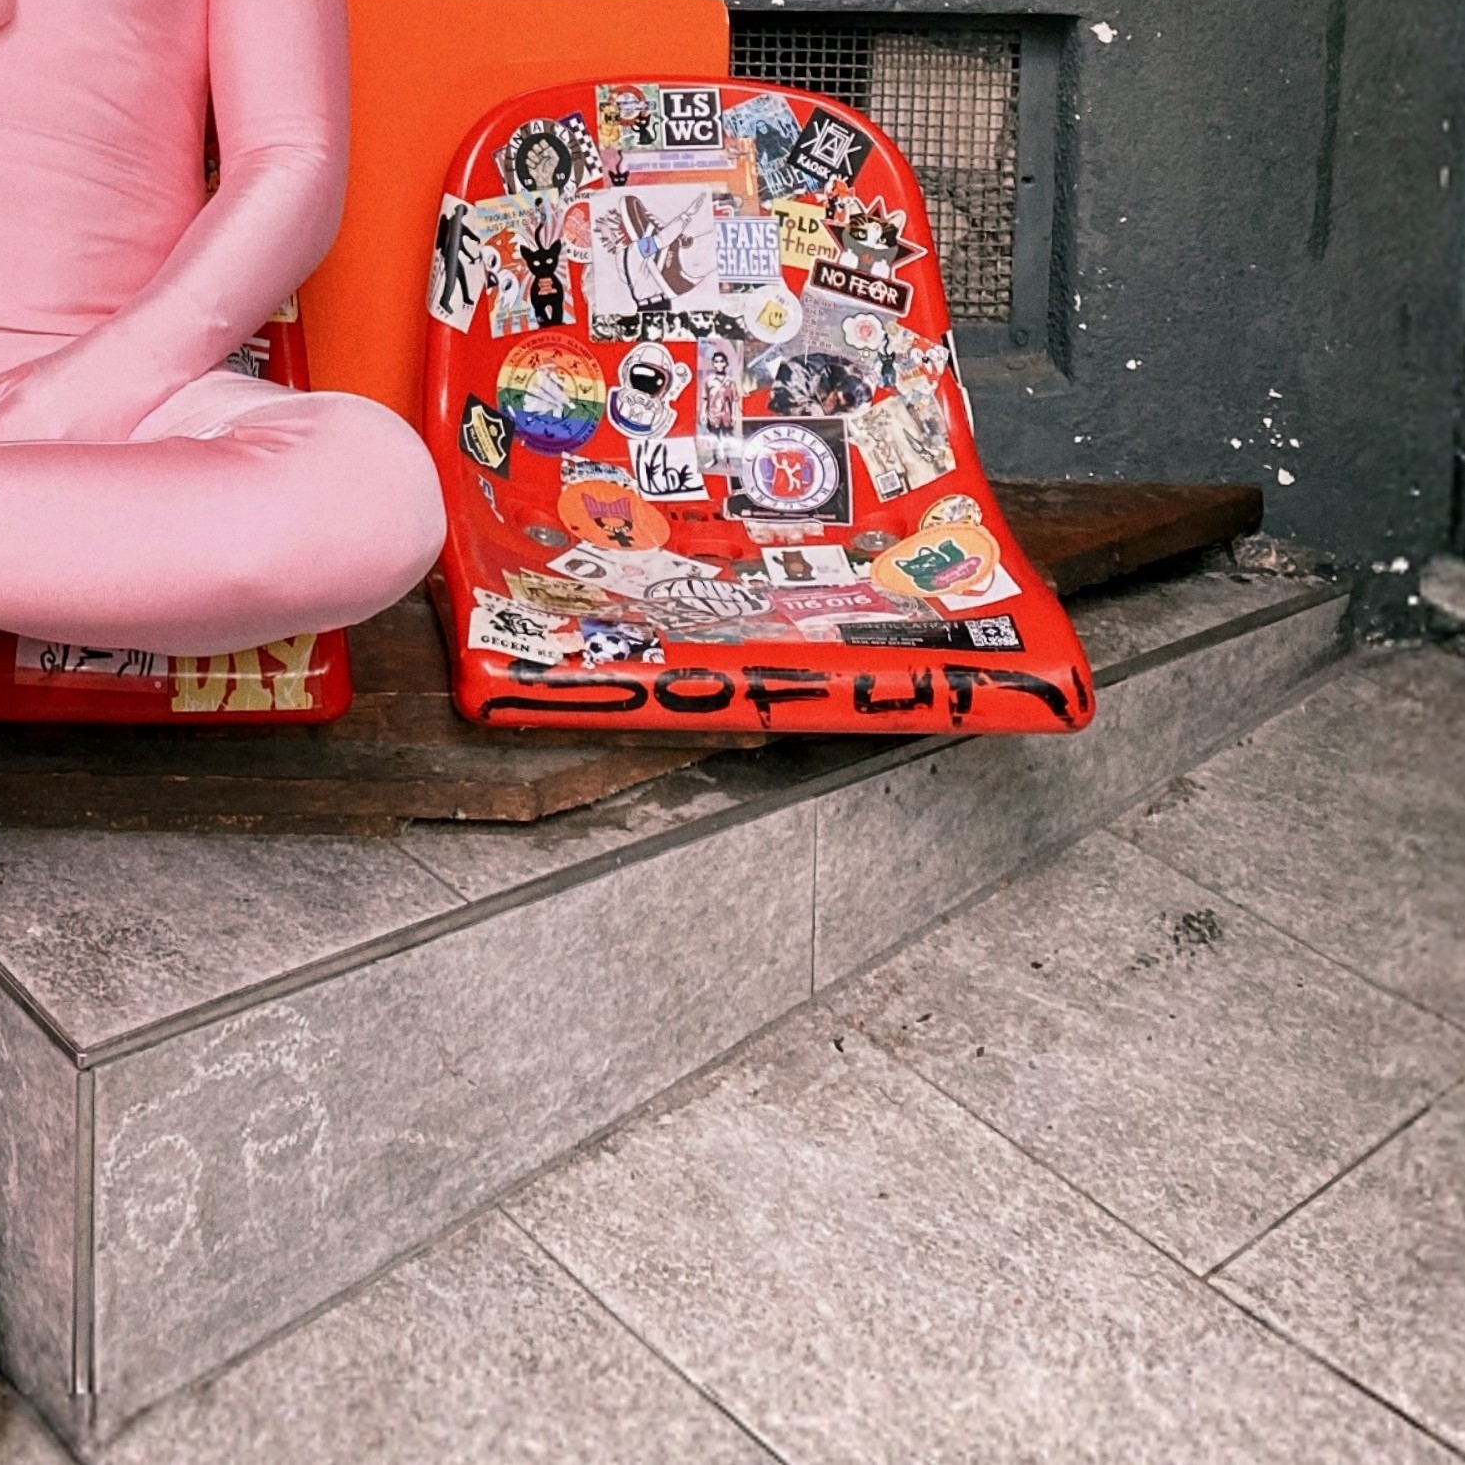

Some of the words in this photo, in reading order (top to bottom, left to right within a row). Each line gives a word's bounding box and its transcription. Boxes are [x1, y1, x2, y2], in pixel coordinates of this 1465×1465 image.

[670, 93, 711, 117] LS
[667, 120, 714, 141] WC
[821, 266, 847, 288] NO
[849, 276, 899, 305] FEAR
[783, 598, 823, 610] 116
[825, 594, 873, 607] 016
[481, 635, 531, 653] GEGEN
